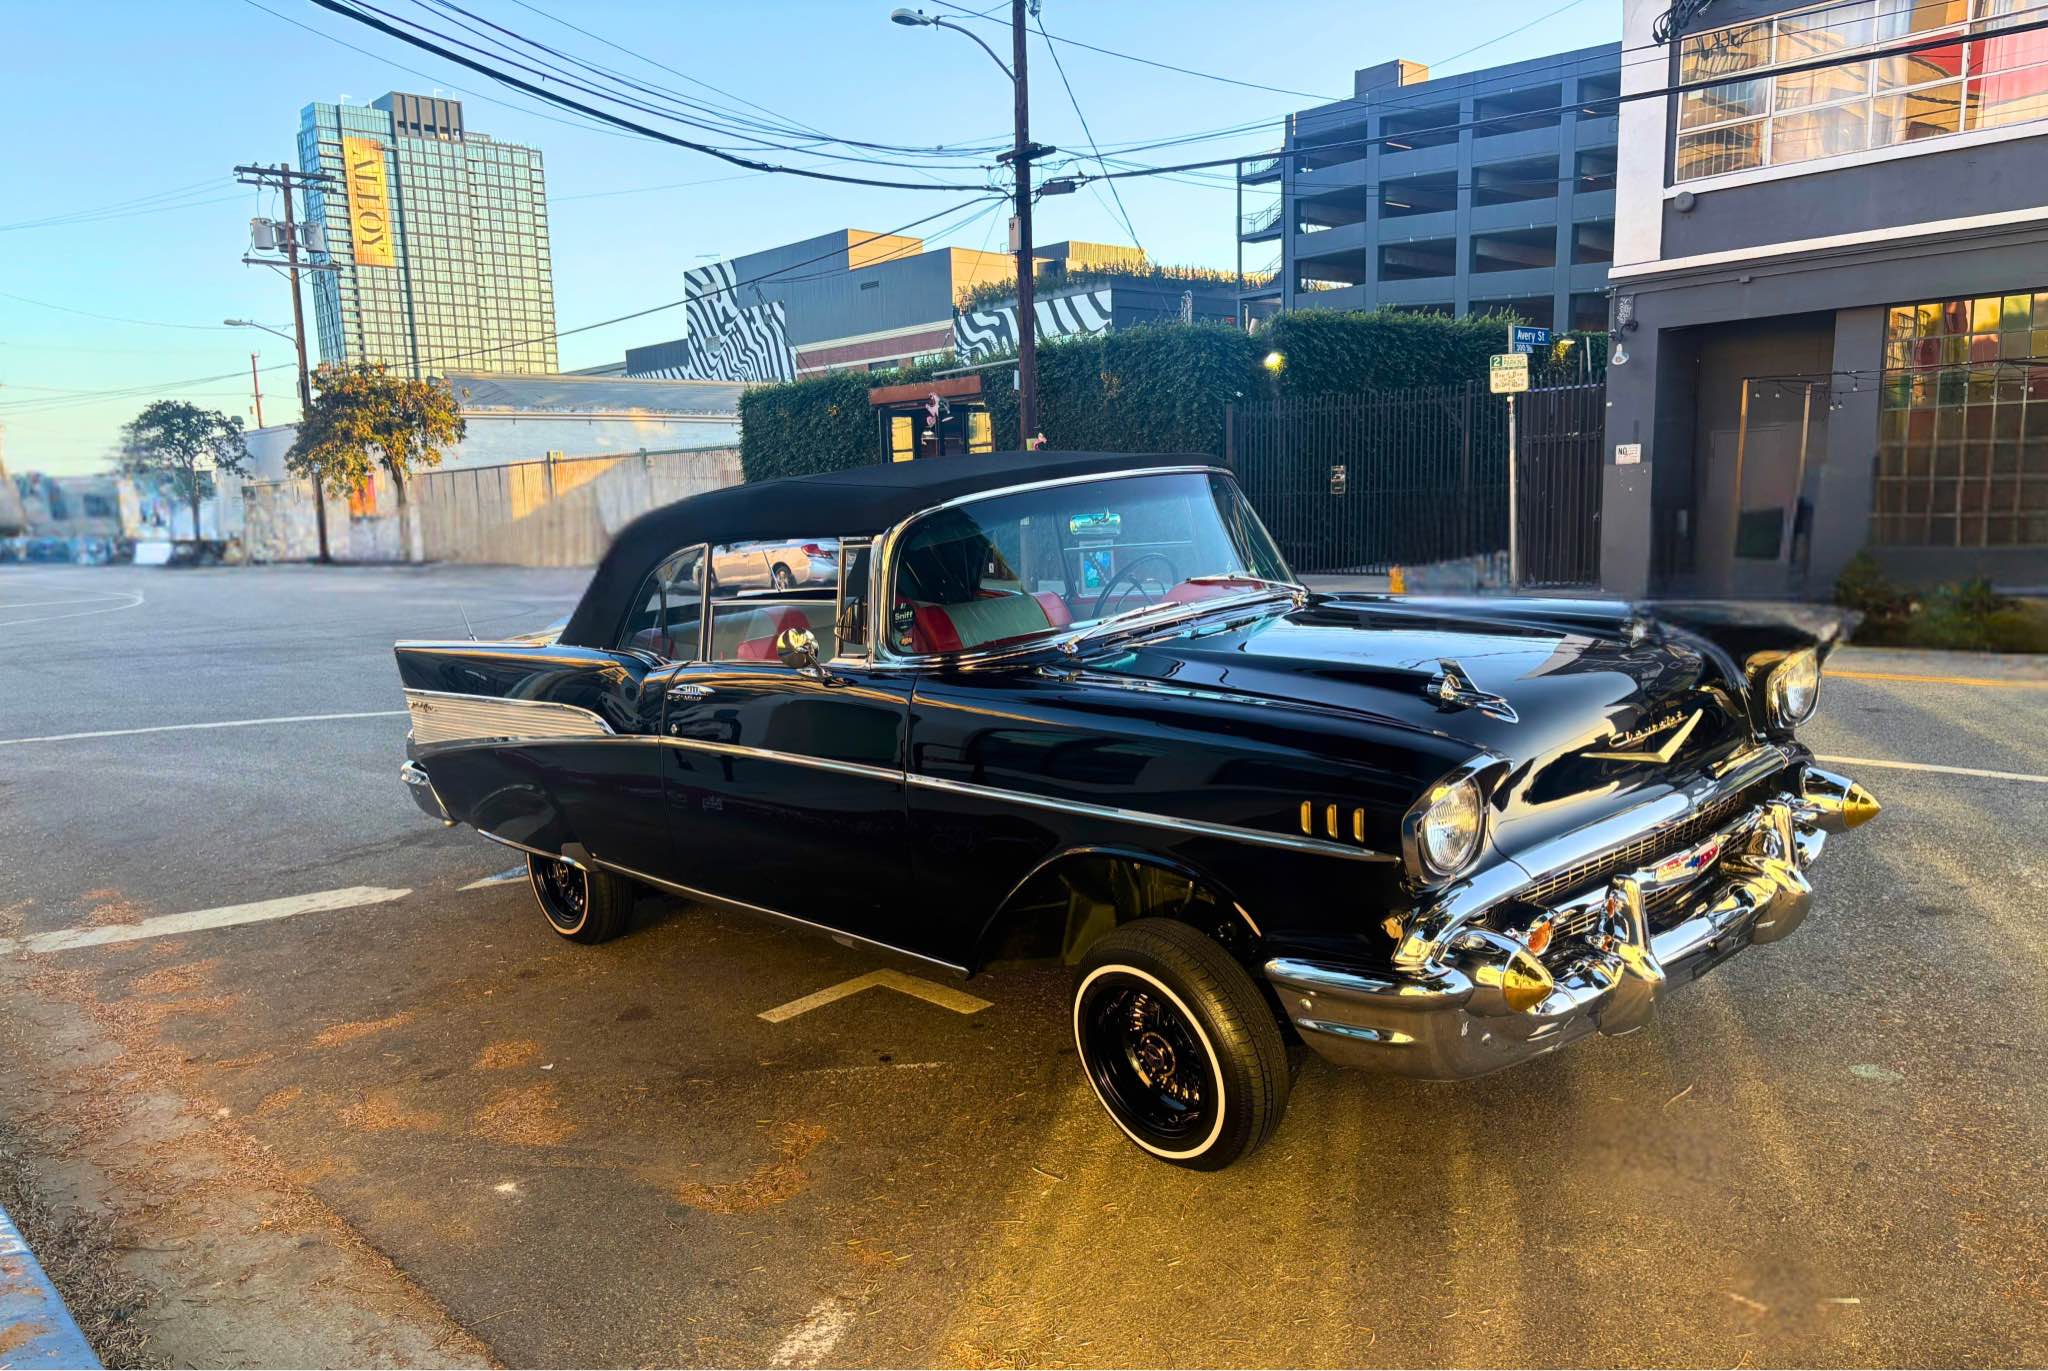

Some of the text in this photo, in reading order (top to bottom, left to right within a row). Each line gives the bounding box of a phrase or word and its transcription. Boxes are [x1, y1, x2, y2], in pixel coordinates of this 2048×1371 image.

[352, 150, 385, 253] ALLOY
[1517, 330, 1545, 343] Avery St
[1493, 357, 1501, 367] 2
[894, 611, 913, 621] Sniff
